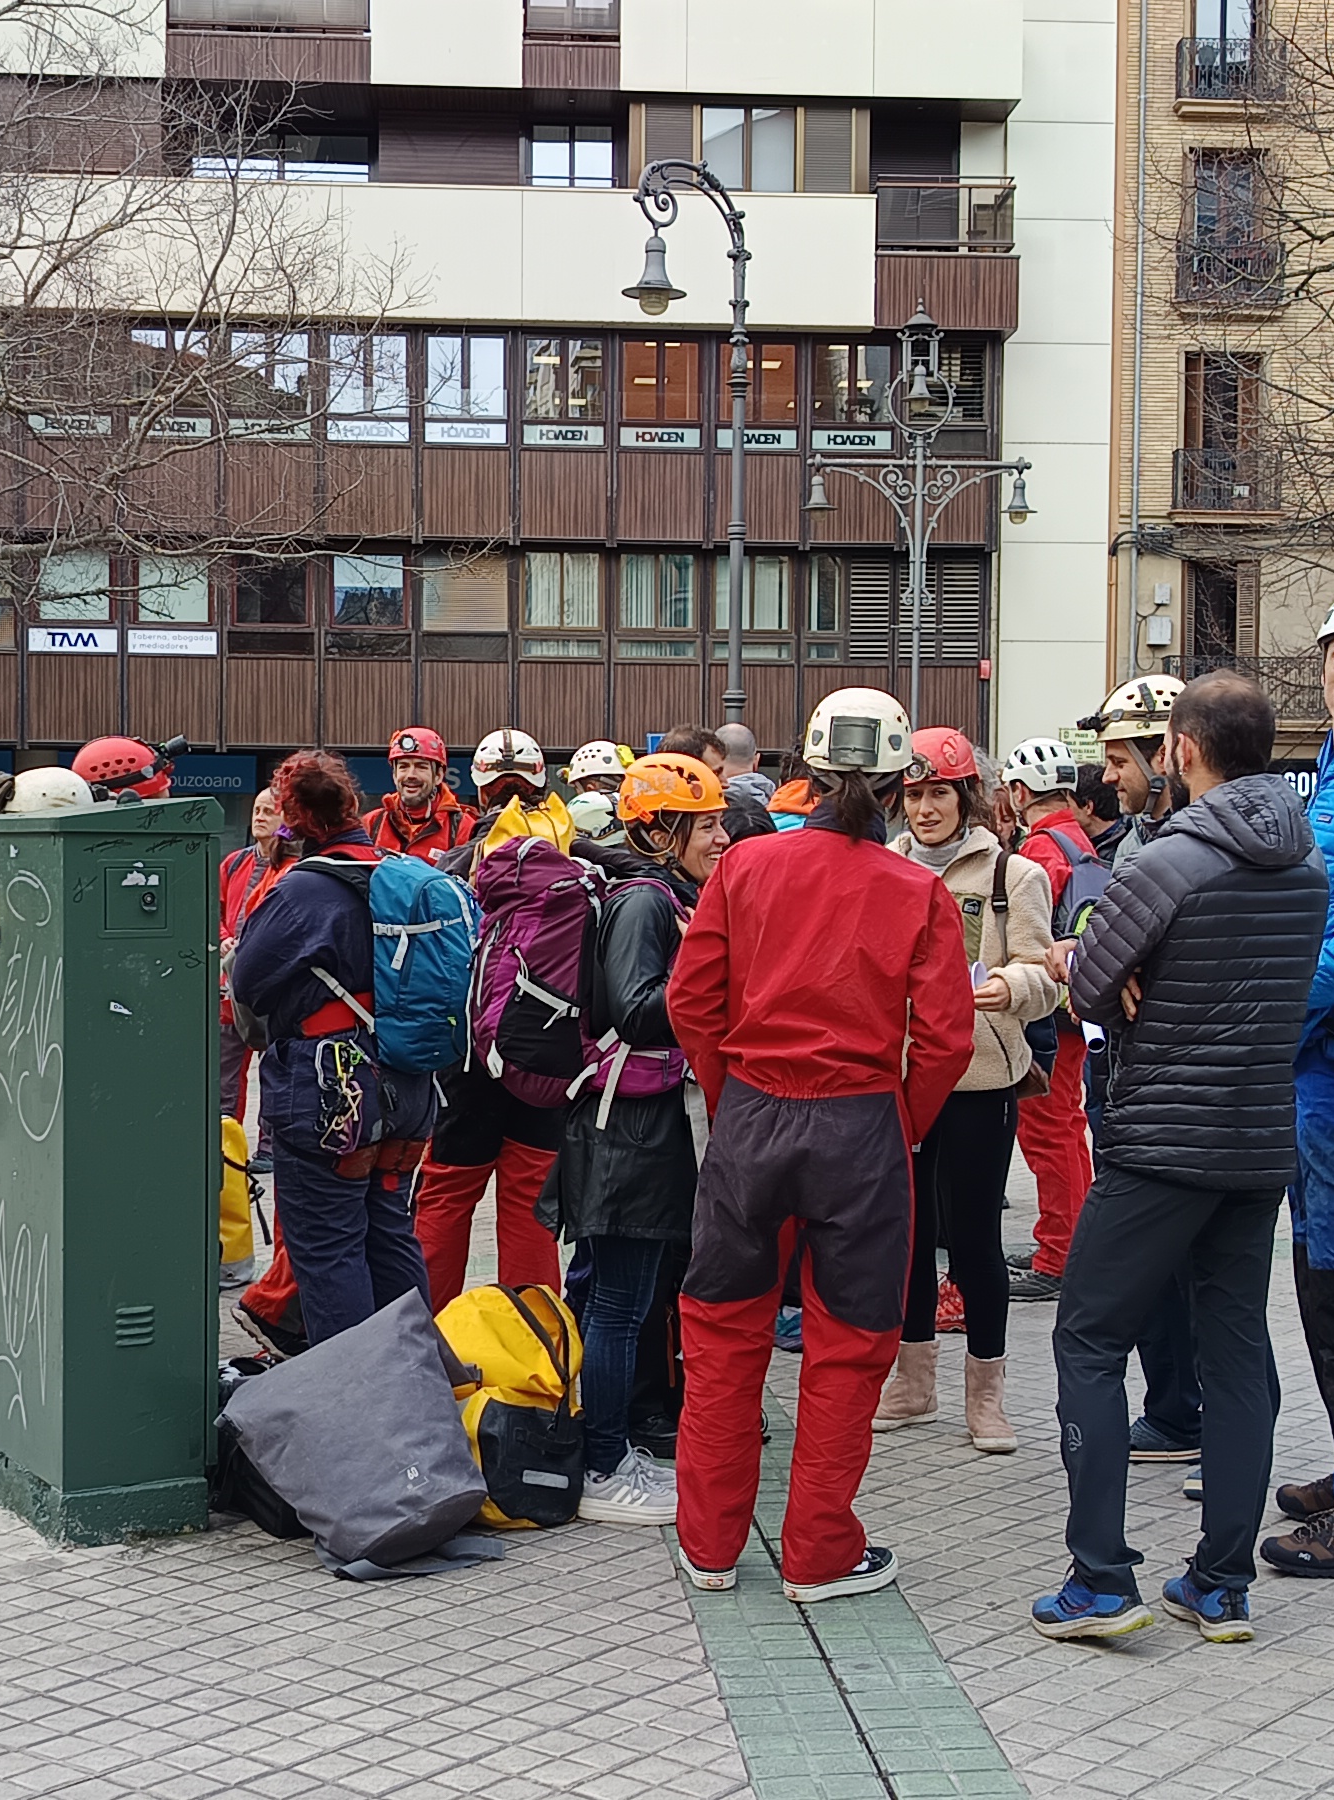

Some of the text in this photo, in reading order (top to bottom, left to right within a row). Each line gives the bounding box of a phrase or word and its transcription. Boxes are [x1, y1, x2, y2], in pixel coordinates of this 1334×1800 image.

[539, 428, 589, 441] HOWDEN
[635, 430, 685, 443] HOWDEN
[827, 433, 876, 446] HOWDEN
[47, 631, 99, 648] TAM
